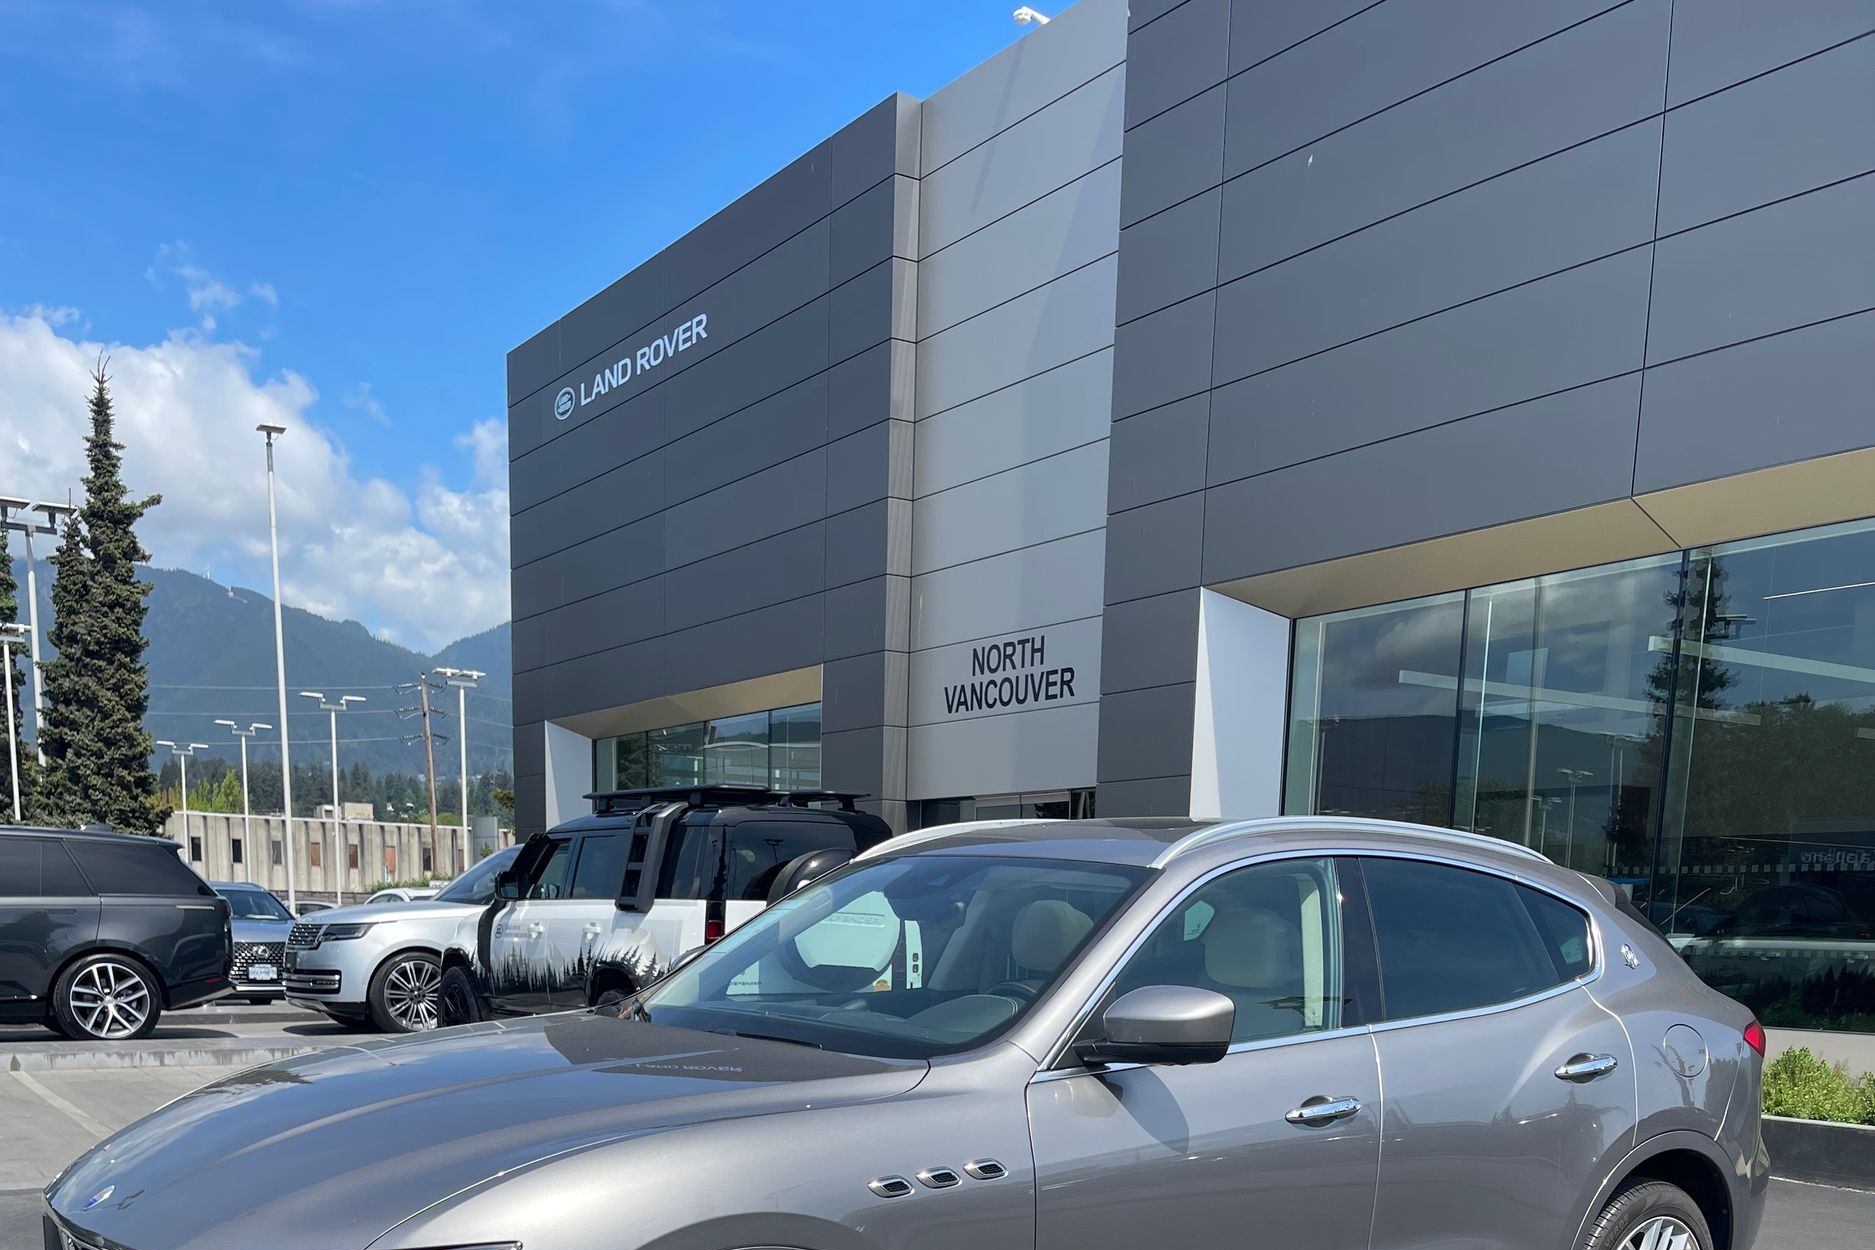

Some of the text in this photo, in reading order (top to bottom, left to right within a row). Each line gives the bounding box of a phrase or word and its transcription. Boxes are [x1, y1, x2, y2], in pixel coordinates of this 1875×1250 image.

[580, 313, 707, 406] LAND ROVER
[972, 635, 1045, 676] NORTH
[944, 667, 1075, 714] VANCOUVER
